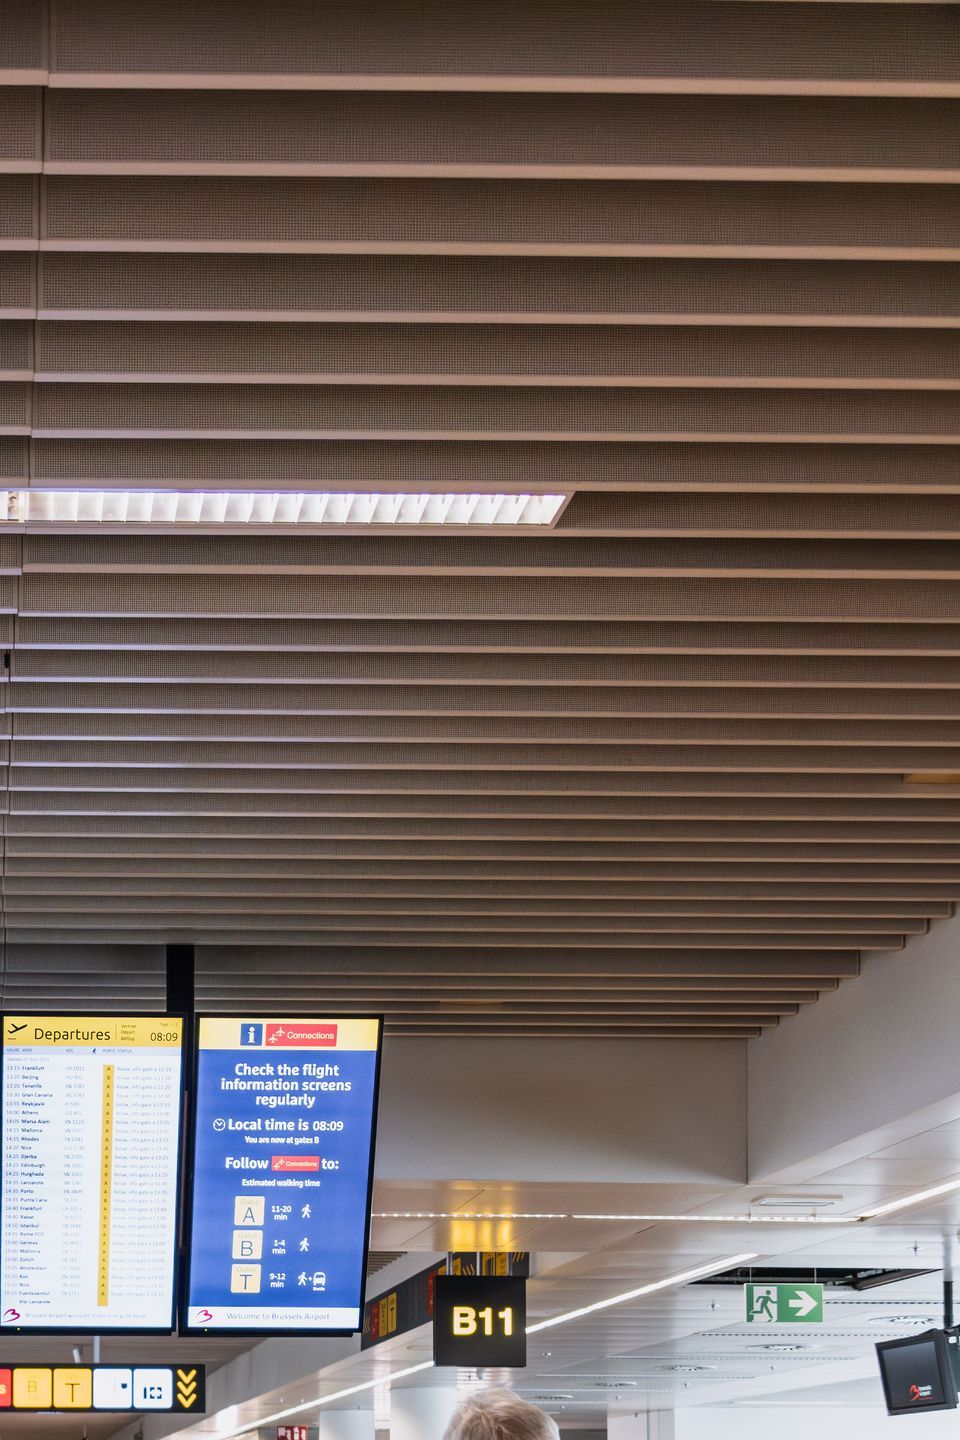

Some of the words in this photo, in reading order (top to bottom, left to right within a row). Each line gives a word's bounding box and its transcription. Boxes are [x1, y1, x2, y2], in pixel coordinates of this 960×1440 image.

[34, 1028, 110, 1042] Departures
[150, 1032, 178, 1041] 08:09
[235, 1063, 274, 1076] Check
[277, 1064, 299, 1076] the
[303, 1064, 339, 1078] flight
[221, 1078, 298, 1091] information
[301, 1080, 351, 1091] screens
[256, 1094, 316, 1108] regularly
[228, 1119, 261, 1130] Local
[265, 1119, 295, 1130] time
[298, 1119, 308, 1130] is
[313, 1120, 344, 1131] 08:09
[294, 1136, 313, 1145] gates
[225, 1157, 268, 1169] Follow
[322, 1159, 339, 1169] to:
[277, 1179, 303, 1188] walking
[243, 1207, 255, 1222] A
[241, 1241, 252, 1256] B
[240, 1275, 252, 1290] T
[453, 1306, 512, 1336] B11
[65, 1383, 81, 1403] T
